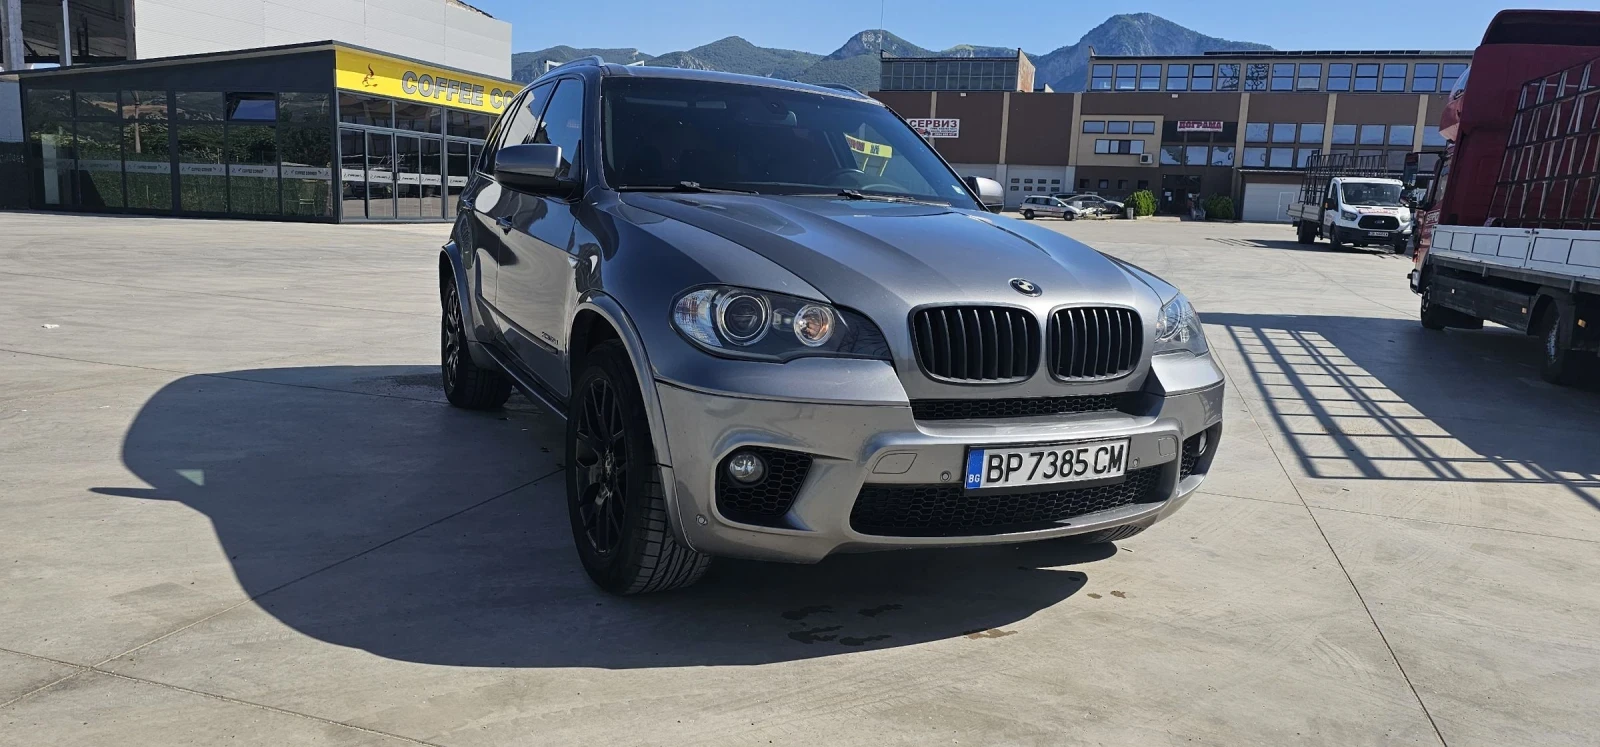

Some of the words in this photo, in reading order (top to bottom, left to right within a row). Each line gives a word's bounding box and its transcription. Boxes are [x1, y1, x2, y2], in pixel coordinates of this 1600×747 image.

[402, 70, 484, 106] COFFEE
[910, 119, 957, 128] СЕРВИЗ
[987, 453, 1023, 483] BP
[1027, 448, 1089, 481] 7385
[1094, 444, 1124, 474] CM
[968, 473, 981, 484] BG
